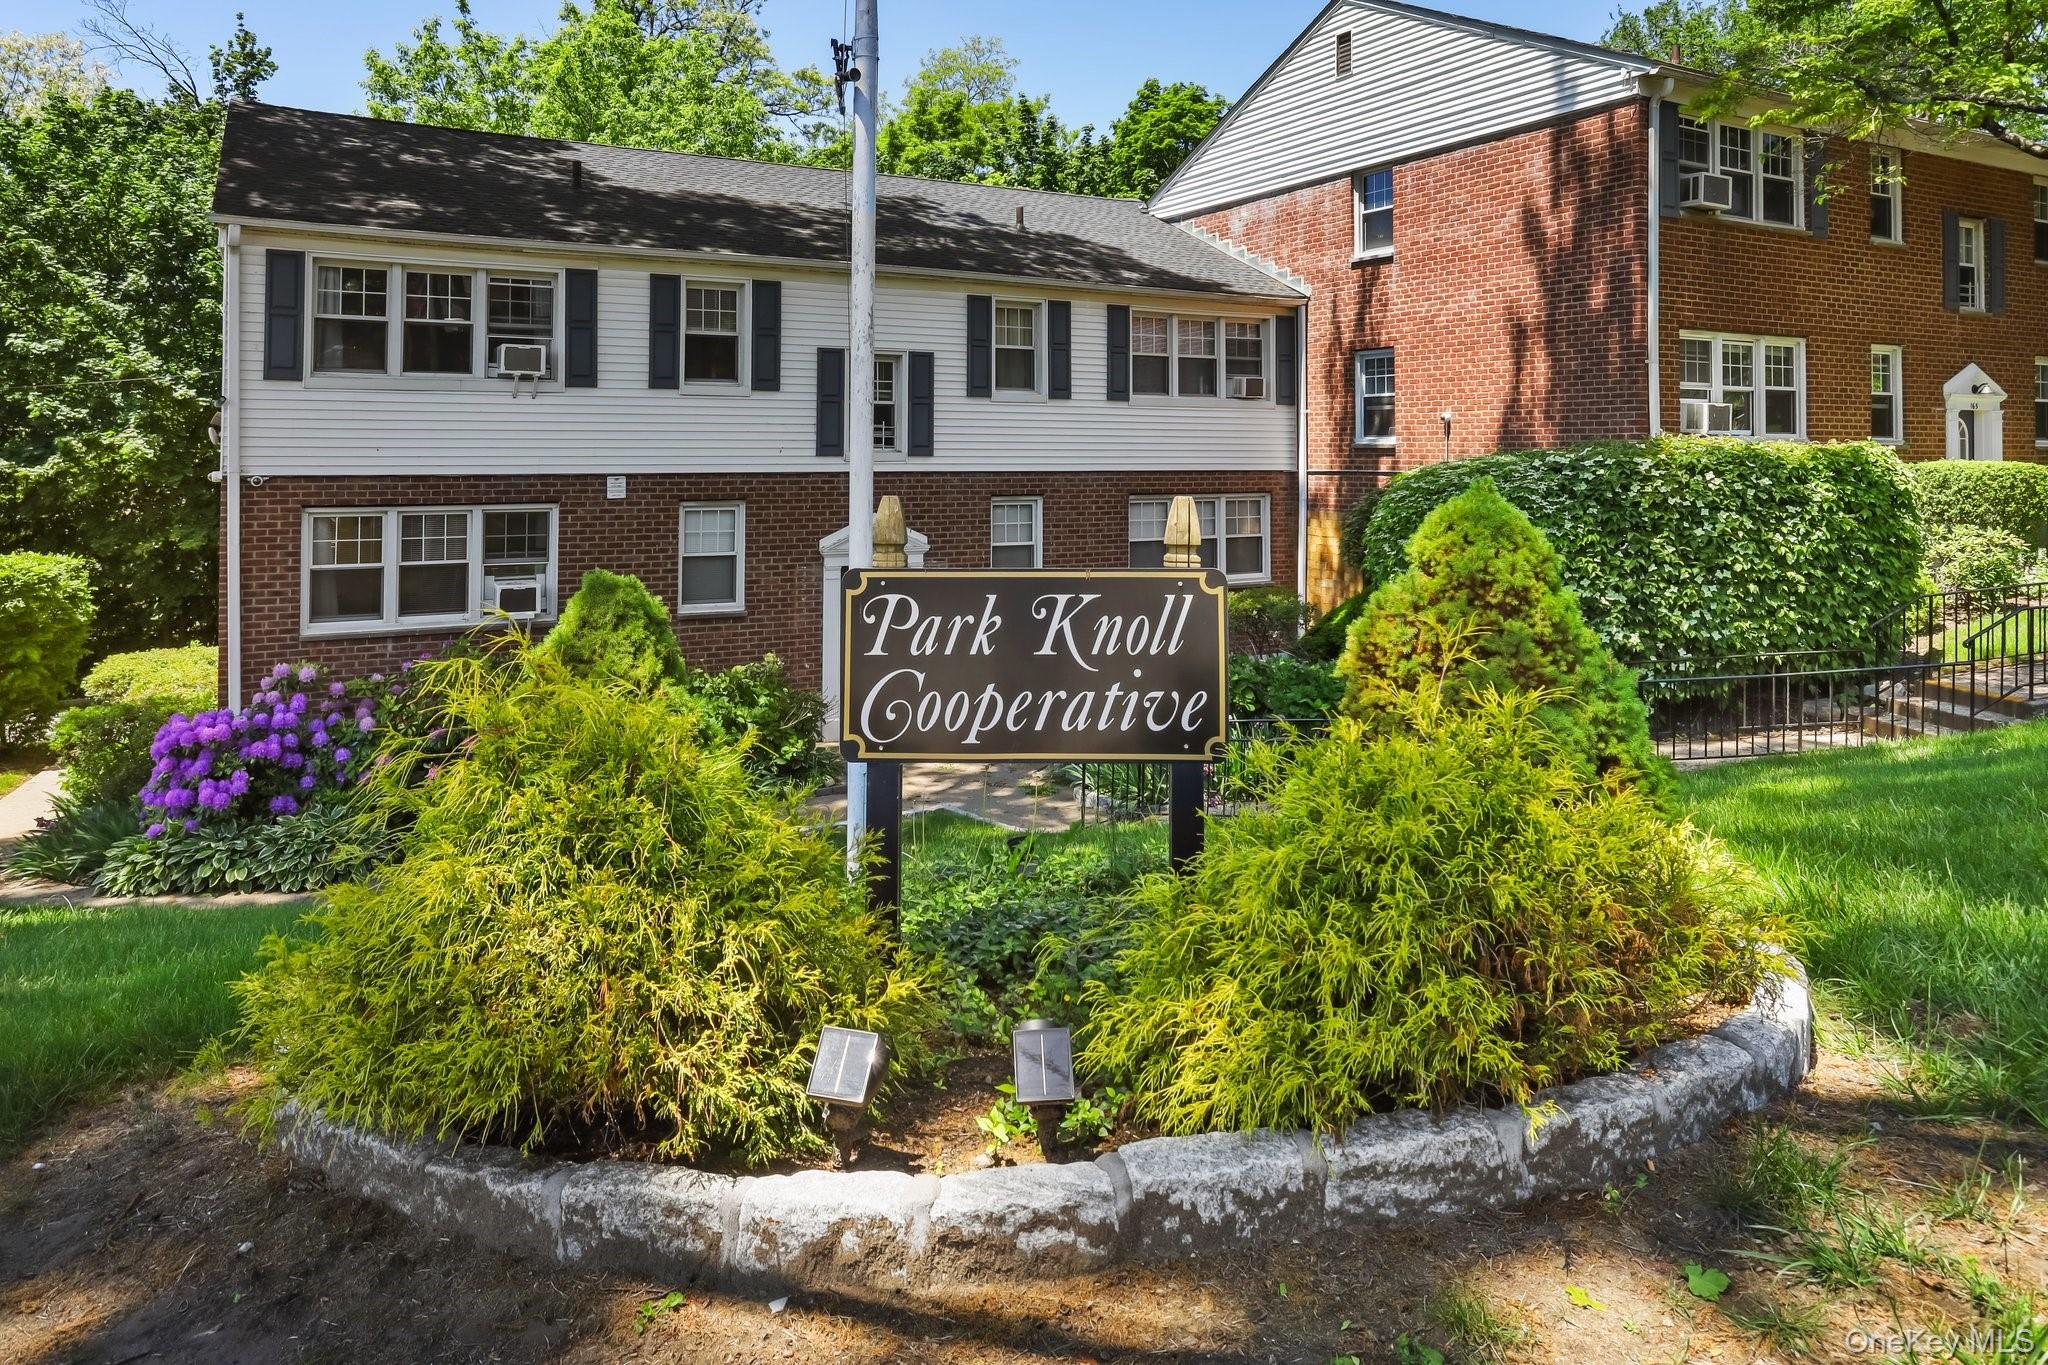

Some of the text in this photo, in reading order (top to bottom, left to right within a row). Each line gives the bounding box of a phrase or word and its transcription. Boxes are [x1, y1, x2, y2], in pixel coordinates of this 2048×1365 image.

[863, 593, 1195, 672] Park Knoll
[860, 668, 1208, 745] Cooperative
